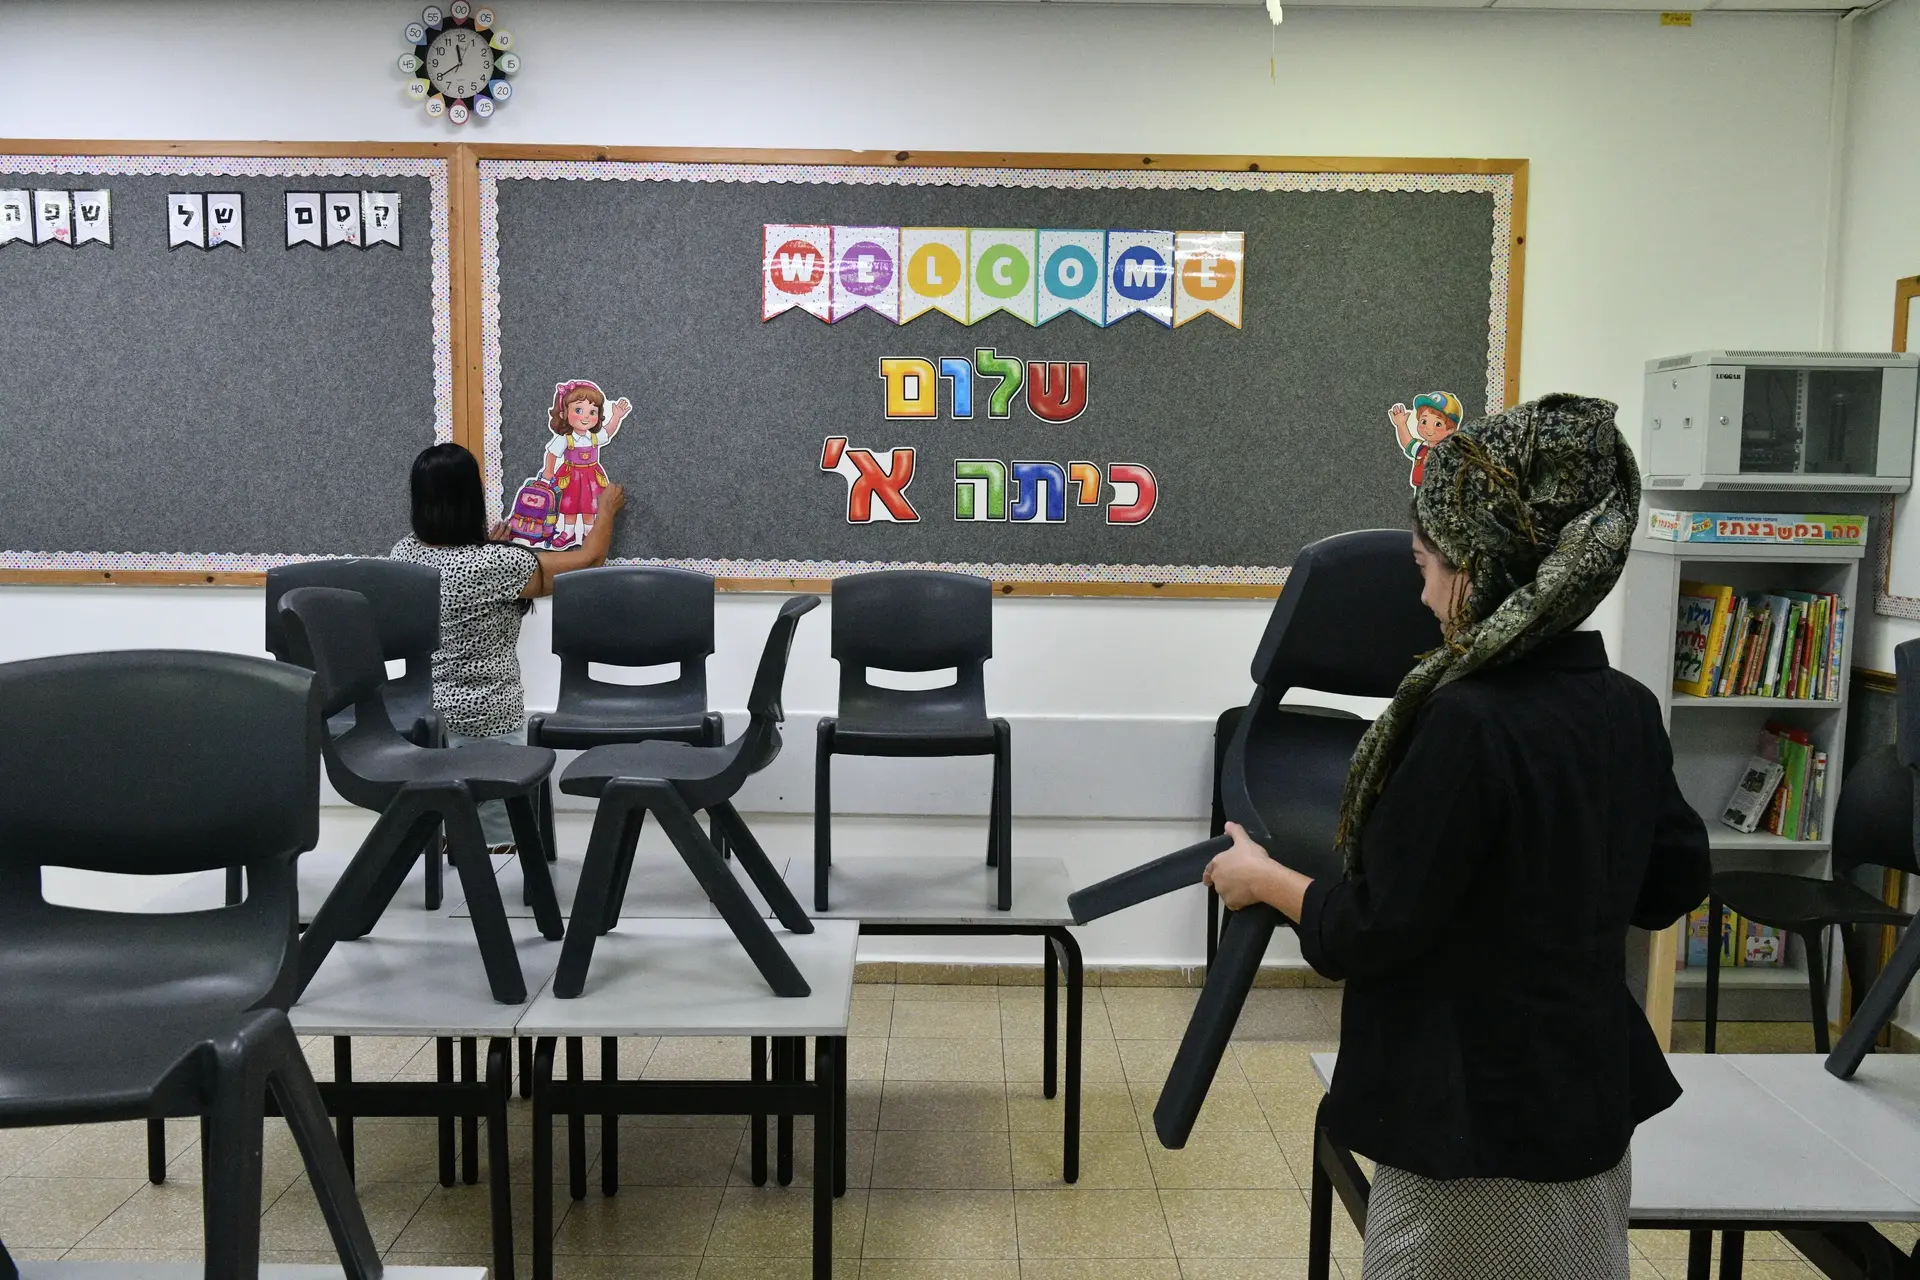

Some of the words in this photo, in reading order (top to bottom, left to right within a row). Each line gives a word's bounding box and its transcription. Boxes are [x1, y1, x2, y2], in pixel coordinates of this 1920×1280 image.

[455, 5, 468, 15] 00
[427, 12, 439, 22] 55
[480, 13, 492, 23] 05
[409, 28, 422, 38] 50
[445, 38, 452, 47] 11
[456, 34, 466, 43] 12
[471, 39, 475, 47] 1
[500, 36, 509, 46] 10
[436, 47, 446, 56] 10
[480, 48, 487, 57] 2
[403, 60, 414, 69] 45
[432, 59, 439, 68] 9
[483, 60, 490, 69] 3
[507, 60, 516, 69] 15
[436, 72, 443, 82] 8
[480, 74, 486, 83] 4
[411, 84, 423, 94] 40
[446, 81, 452, 90] 7
[457, 85, 464, 95] 6
[470, 82, 477, 91] 5
[497, 86, 509, 96] 20
[430, 103, 442, 113] 35
[480, 102, 492, 112] 25
[453, 109, 465, 119] 30
[780, 251, 1219, 290] WELCOME
[881, 348, 1089, 423] שלום
[954, 459, 1158, 525] כיתה
[1719, 520, 1825, 541] במשבצת?
[1832, 523, 1861, 539] מה
